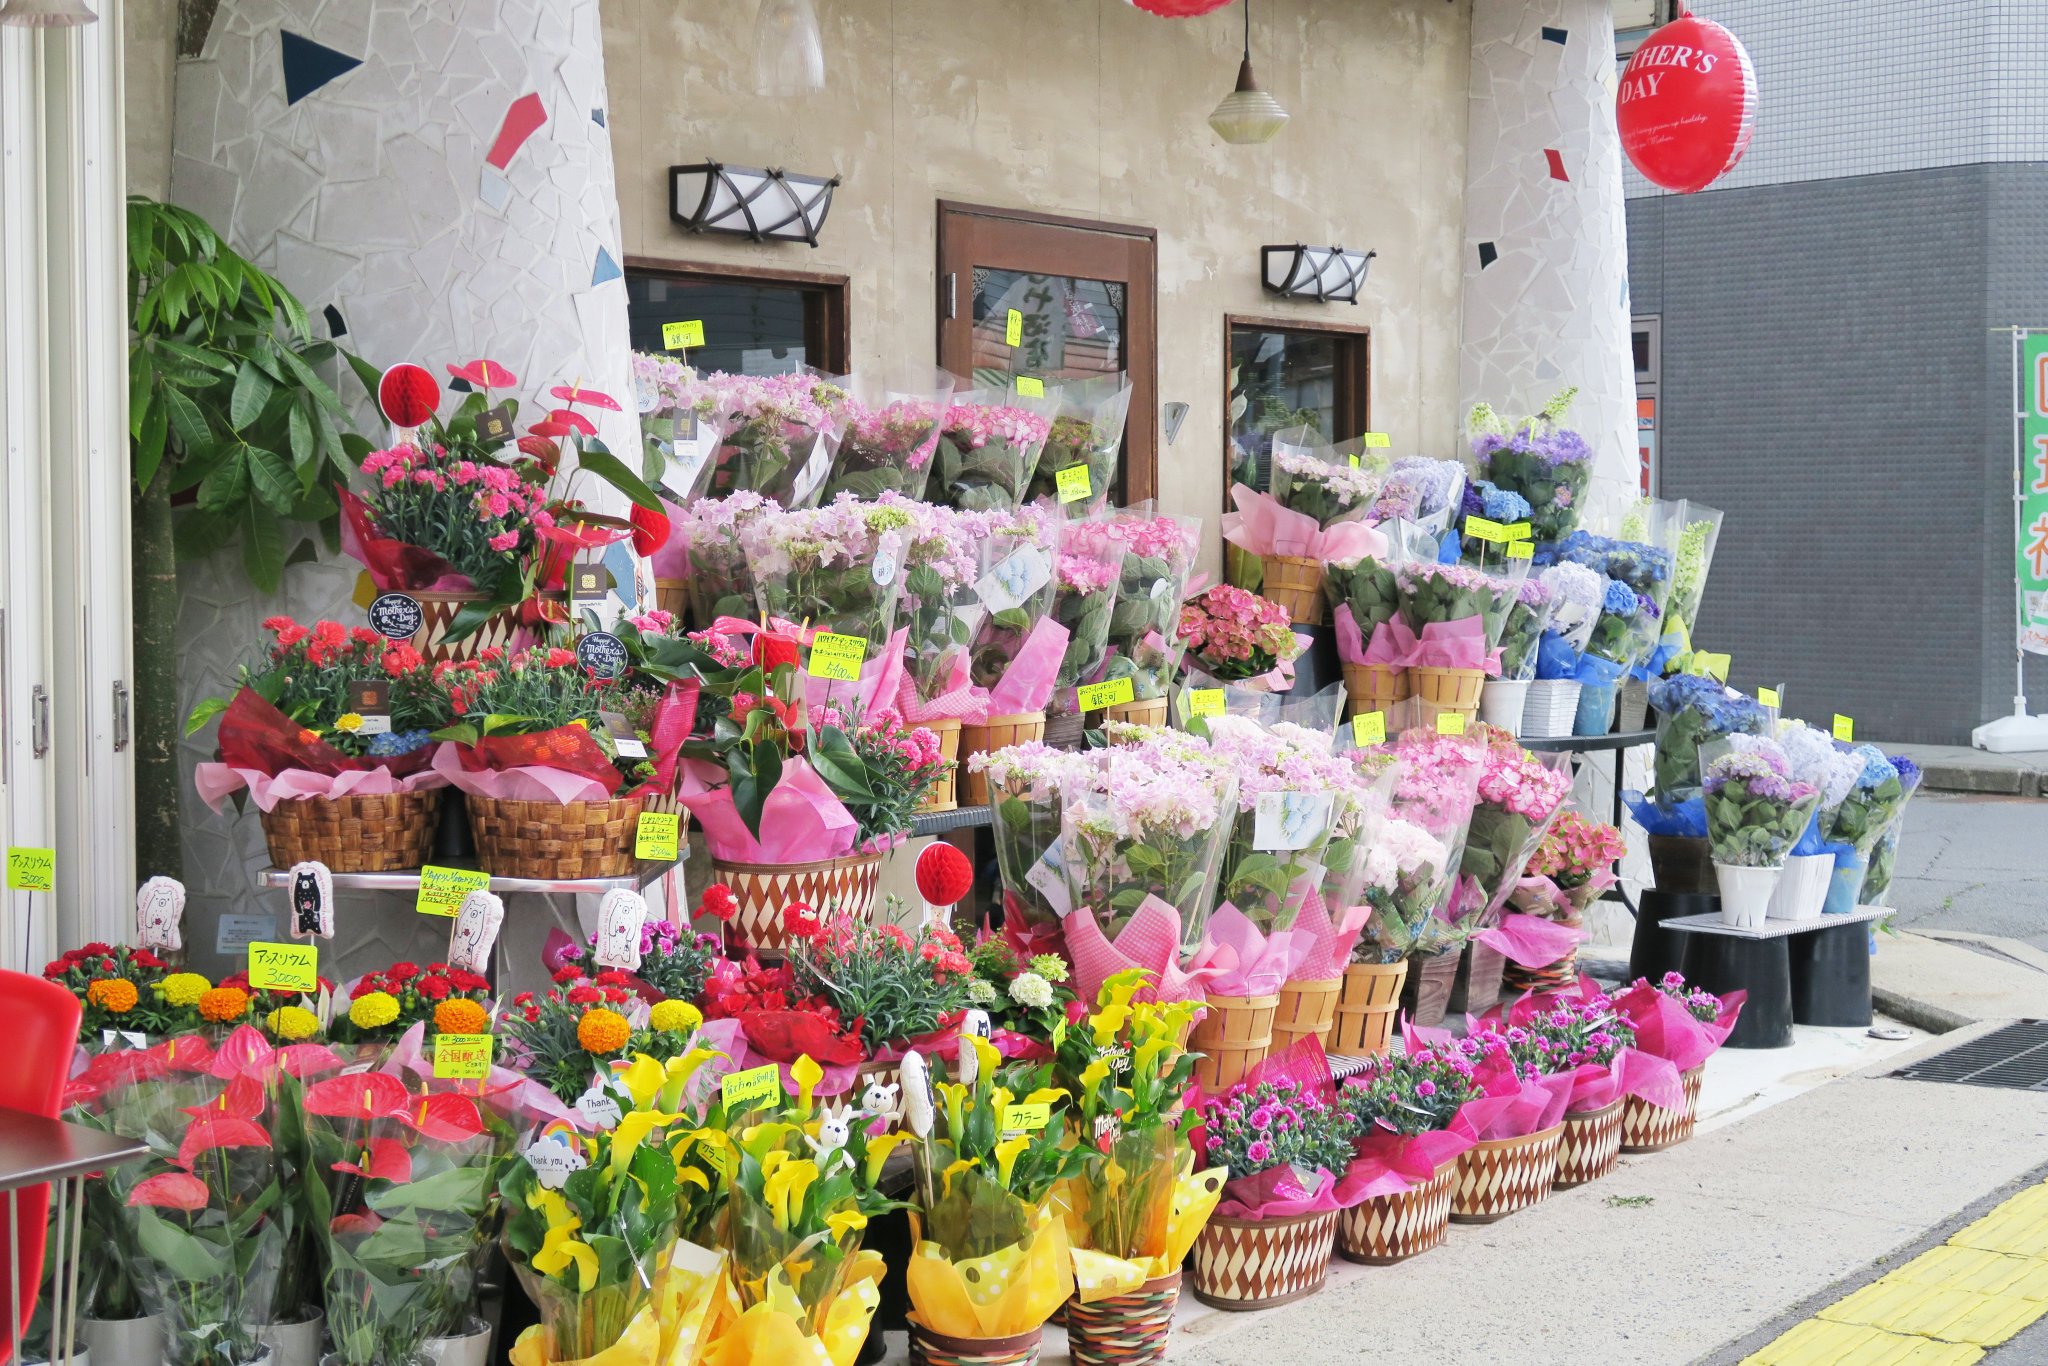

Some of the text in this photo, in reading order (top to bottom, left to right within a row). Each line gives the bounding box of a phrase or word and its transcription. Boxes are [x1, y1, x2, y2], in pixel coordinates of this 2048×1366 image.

[1621, 72, 1665, 105] DAY
[376, 605, 419, 617] Mother's
[397, 613, 418, 626] Day
[584, 643, 624, 656] Mother's
[1091, 691, 1117, 707] 銀河
[10, 854, 53, 870] アンスリウム
[254, 949, 312, 967] アンスリウム
[438, 1048, 489, 1063] 全国配送
[586, 1097, 612, 1109] Thank
[1012, 1111, 1042, 1127] カラー
[529, 1154, 563, 1168] Thank you
[702, 1143, 725, 1164] カラー
